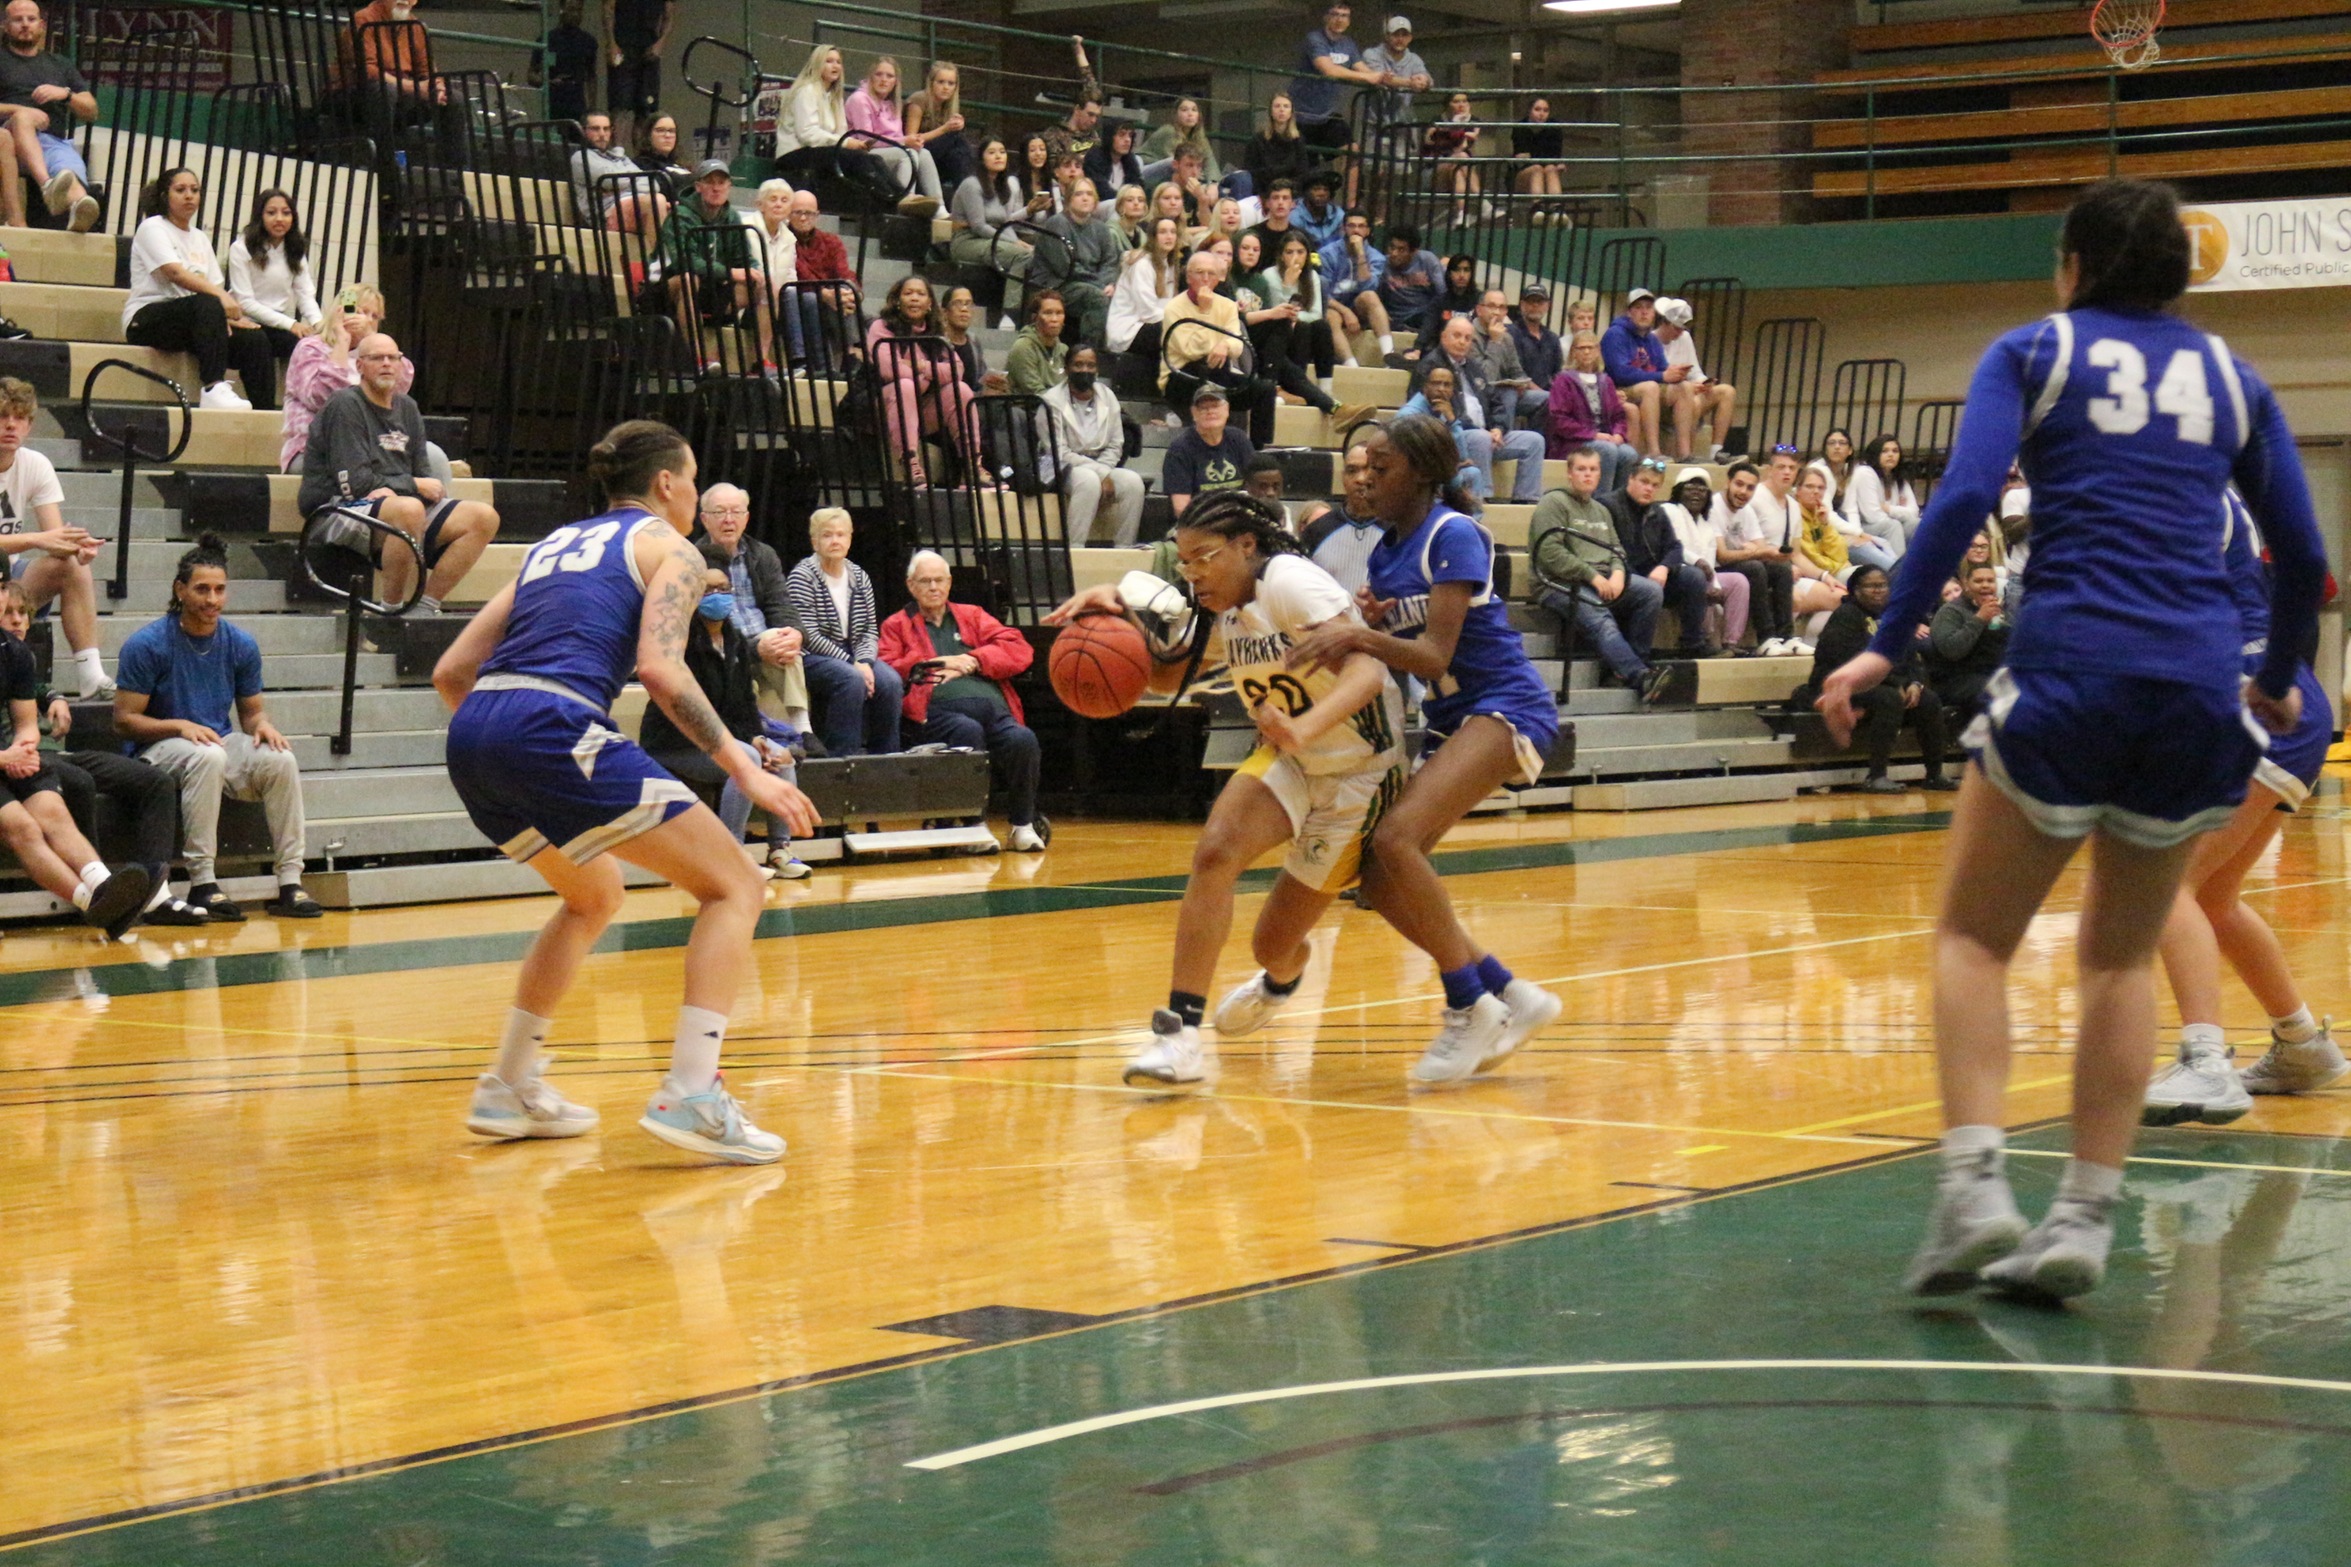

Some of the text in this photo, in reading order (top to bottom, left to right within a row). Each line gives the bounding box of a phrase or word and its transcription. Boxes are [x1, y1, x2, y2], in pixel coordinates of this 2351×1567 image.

[2241, 210, 2322, 257] JOHN
[2240, 261, 2350, 278] Certified Public
[2087, 338, 2215, 446] 34
[521, 520, 621, 587] 23
